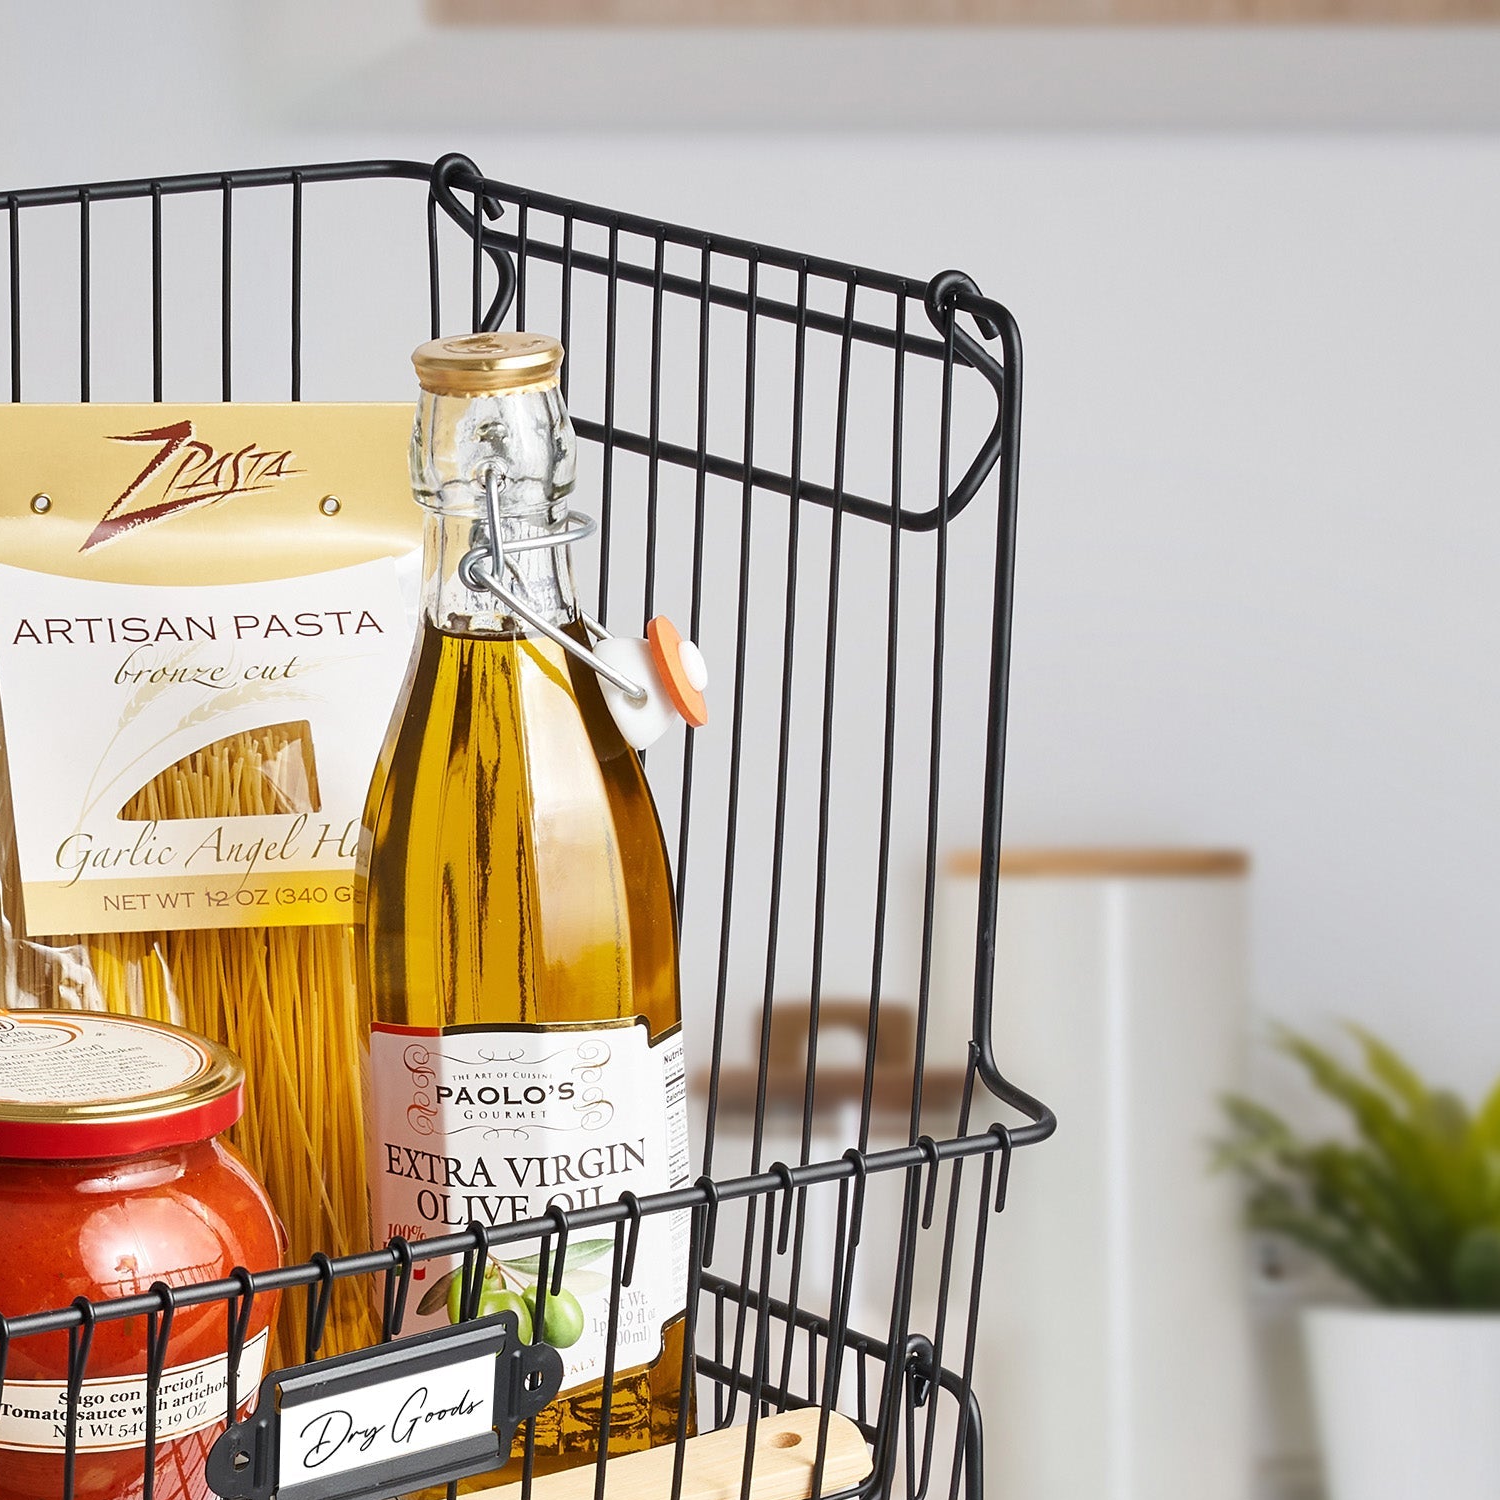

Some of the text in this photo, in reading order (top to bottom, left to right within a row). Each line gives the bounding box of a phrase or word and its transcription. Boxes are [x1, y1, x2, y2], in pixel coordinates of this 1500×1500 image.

[12, 610, 386, 645] ARTISAN PASTA
[113, 643, 300, 689] bronze cut
[55, 813, 361, 901] Garlic Angel Ha
[103, 893, 151, 911] NET
[156, 892, 195, 909] WT
[205, 890, 230, 907] 12
[235, 889, 269, 907] OZ
[275, 886, 328, 906] (340
[435, 1081, 576, 1106] PAOLO'S
[474, 1072, 493, 1080] ART
[463, 1109, 547, 1121] GOURMET
[384, 1142, 498, 1188] EXTRA
[504, 1137, 646, 1188] VIRGIN
[417, 1188, 531, 1227] OLIVE
[0, 1370, 242, 1421] Tomato sauce wh artichoks
[110, 1390, 141, 1404] con
[146, 1371, 205, 1397] arciofi
[53, 1423, 84, 1438] Nt
[90, 1423, 114, 1438] Wt
[168, 1412, 182, 1427] 19
[186, 1401, 208, 1420] OZ
[300, 1386, 485, 1469] Dry Goods
